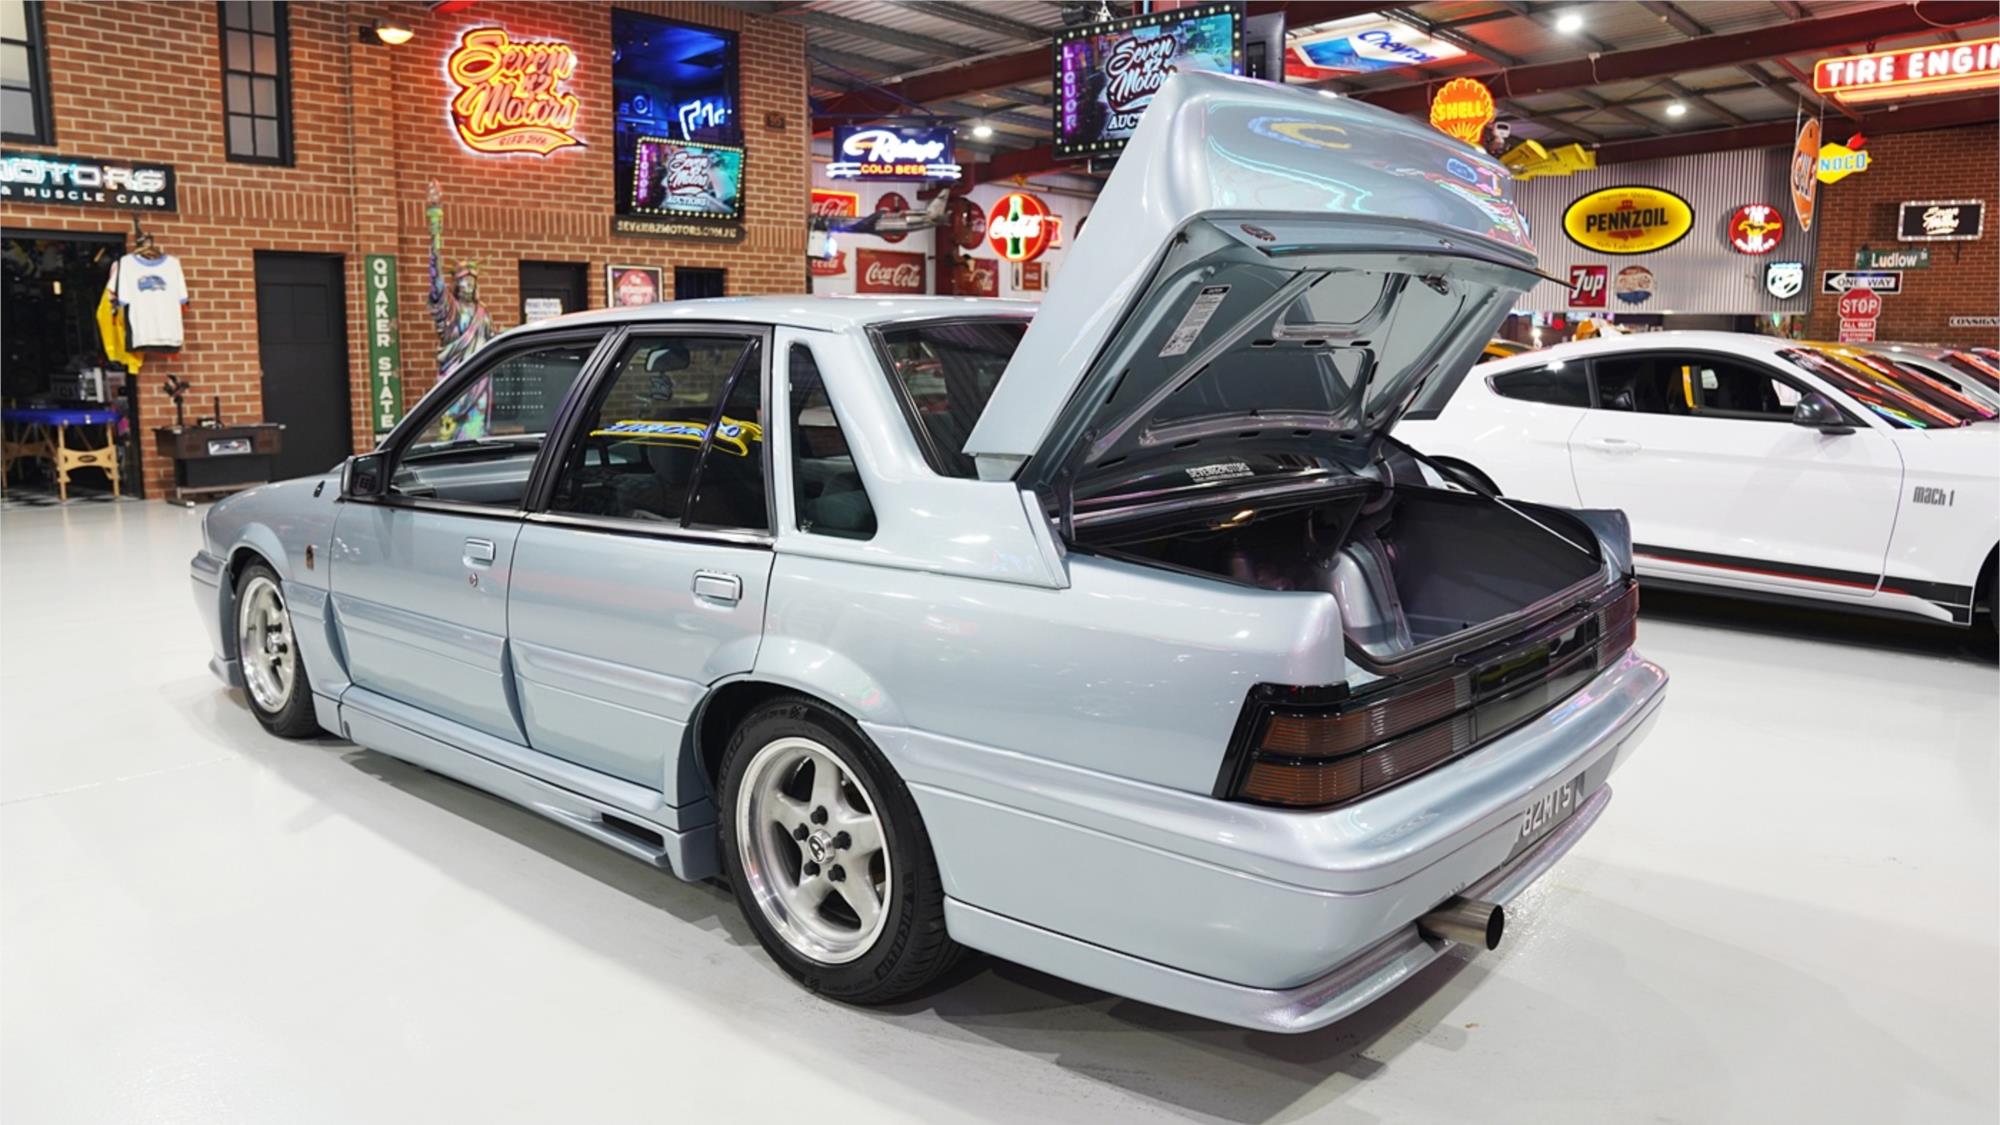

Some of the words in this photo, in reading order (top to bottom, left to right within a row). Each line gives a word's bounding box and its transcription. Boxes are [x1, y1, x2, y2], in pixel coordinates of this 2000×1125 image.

[1826, 55, 1895, 87] TIRE
[1063, 46, 1077, 131] LIQUOR
[1435, 101, 1485, 121] SHELL
[861, 164, 892, 174] COLD
[895, 164, 926, 175] BEER
[1820, 153, 1867, 172] NOCO
[24, 187, 105, 203] MUSCLE
[116, 193, 166, 206] CARS
[1586, 207, 1669, 233] PENNZOIL
[1871, 252, 1918, 268] Ludlow
[1837, 278, 1858, 288] ONE
[1868, 278, 1892, 287] WAY
[373, 258, 391, 347] QUAKER
[1841, 299, 1878, 314] STOP
[1843, 321, 1857, 329] ALL
[378, 356, 394, 429] STATE
[1949, 489, 1955, 507] 1
